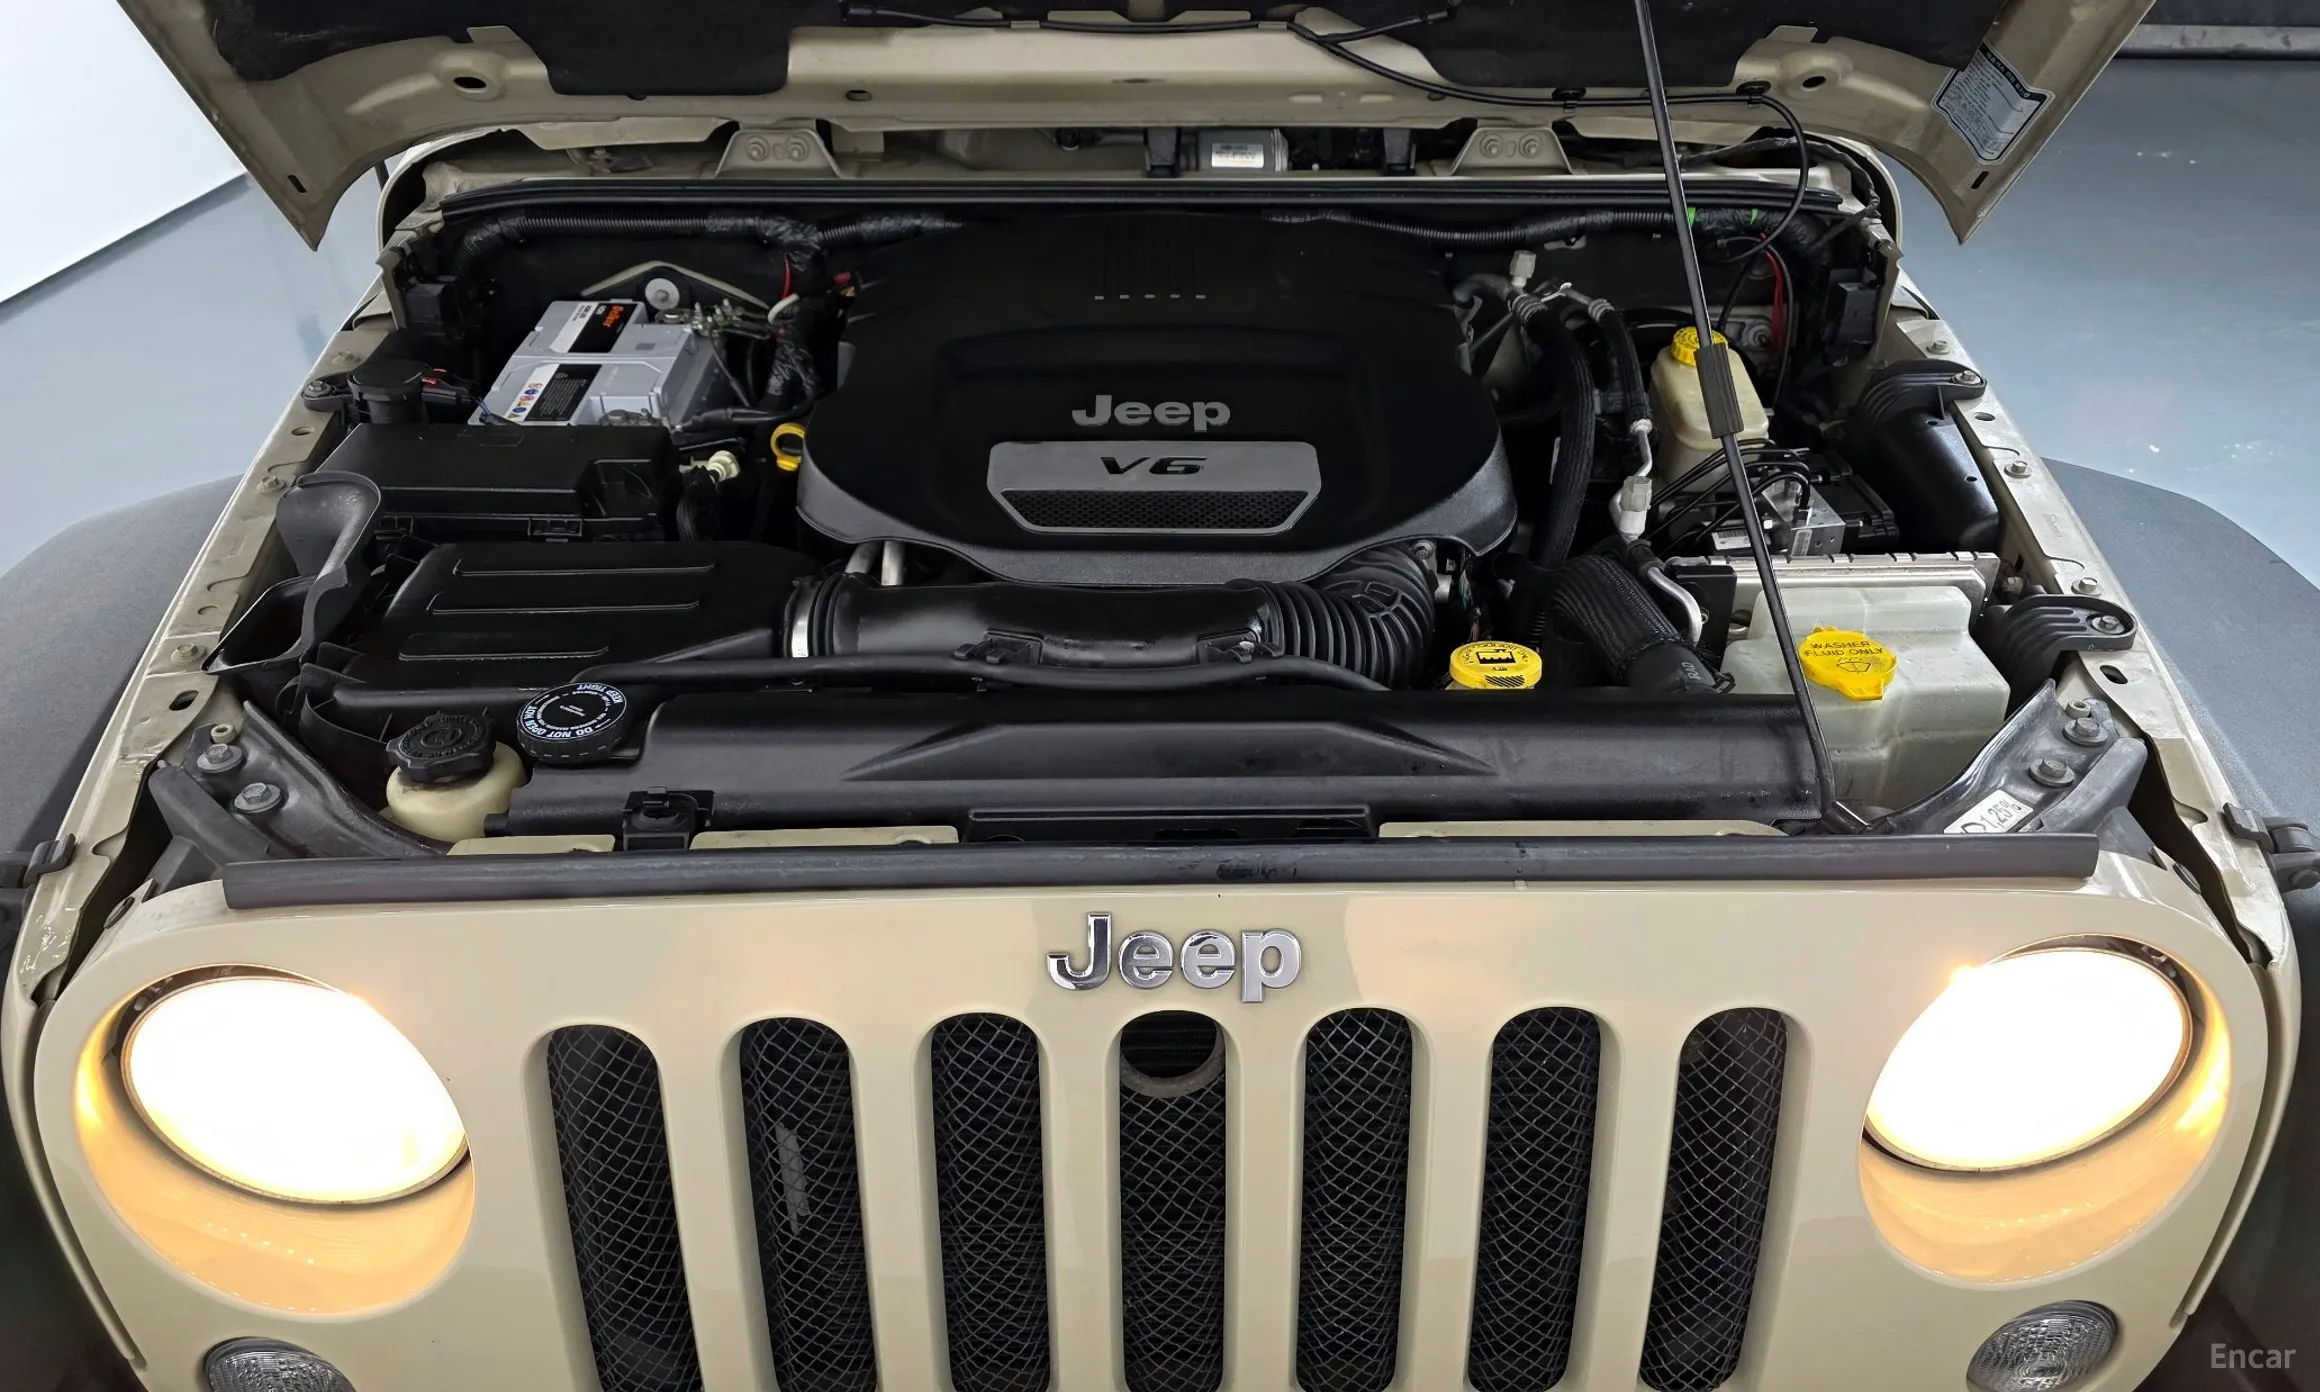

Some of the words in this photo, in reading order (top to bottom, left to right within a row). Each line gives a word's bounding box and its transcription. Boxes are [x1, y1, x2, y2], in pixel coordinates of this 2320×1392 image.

[1071, 394, 1231, 433] Jeep
[1100, 456, 1207, 475] V6
[1805, 649, 1845, 657] FLUID
[1848, 647, 1884, 656] ONLY
[1811, 640, 1871, 649] WASHER
[576, 683, 607, 692] TIGHT
[605, 689, 624, 704] KEEP
[523, 705, 538, 720] HOT
[524, 720, 547, 735] OPEN
[546, 730, 571, 738] NOT
[575, 726, 593, 737] DO
[1046, 911, 1303, 1004] Jeep
